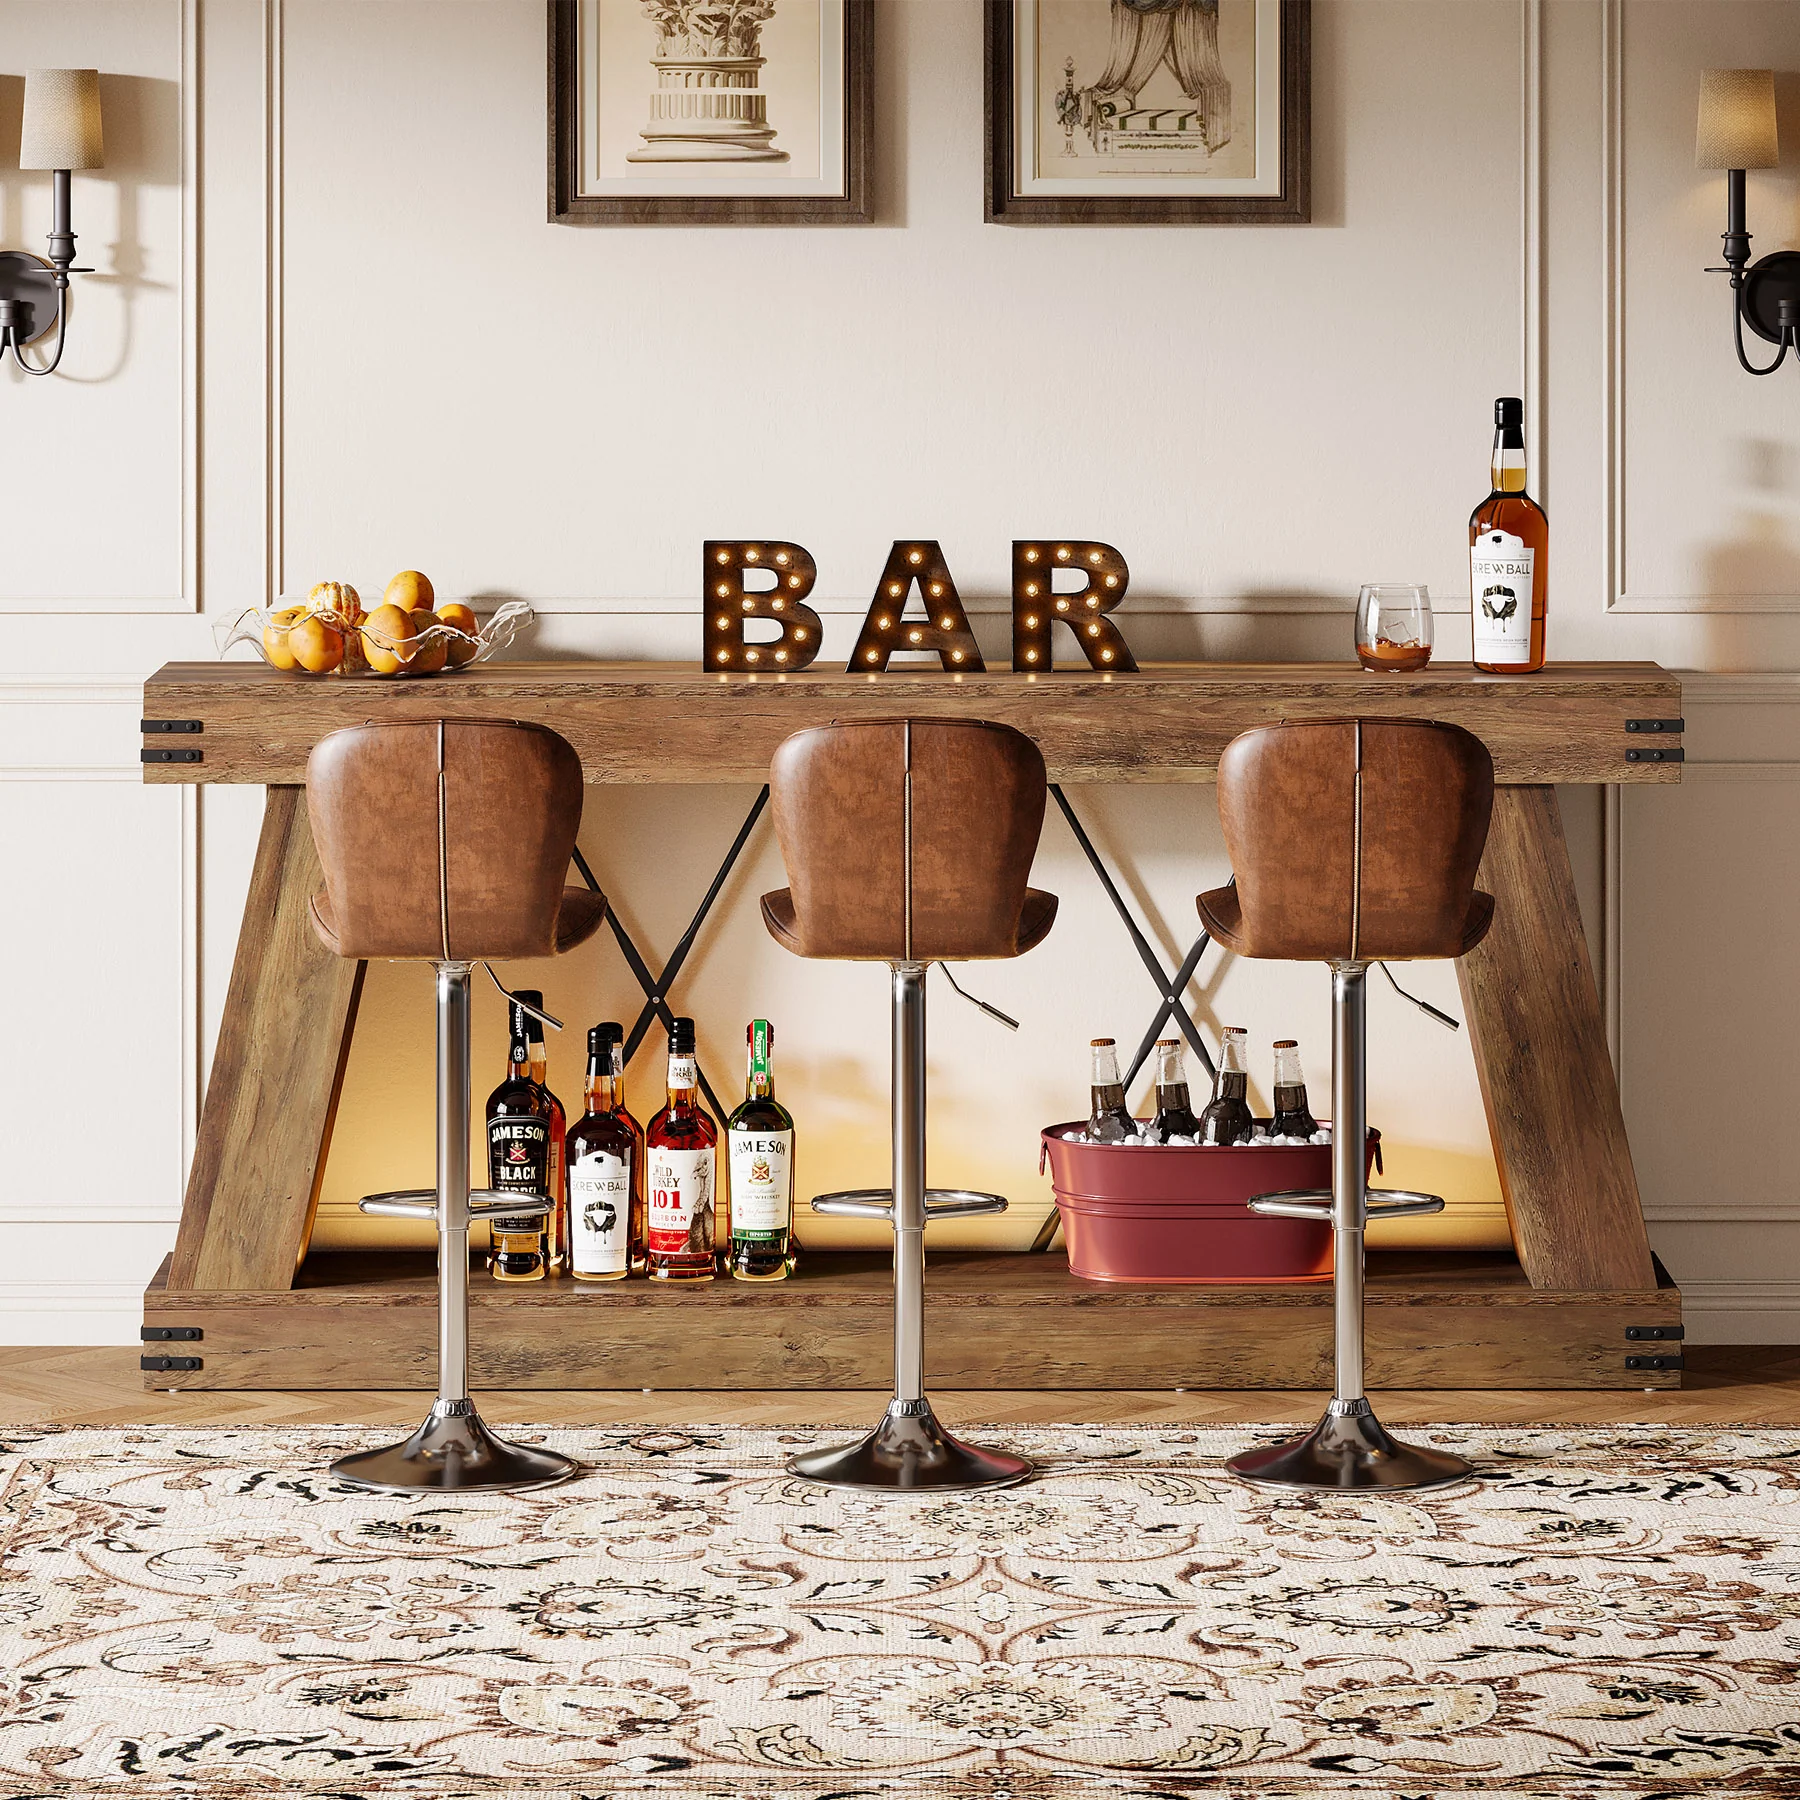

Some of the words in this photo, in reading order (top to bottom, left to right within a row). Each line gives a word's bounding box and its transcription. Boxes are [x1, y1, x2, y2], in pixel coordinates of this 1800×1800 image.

[704, 540, 1140, 674] BAR
[755, 1030, 765, 1065] JAMESON
[491, 1125, 545, 1143] JAMESON
[734, 1140, 788, 1157] JAMESON
[500, 1165, 536, 1180] BLACK
[652, 1190, 684, 1210] 101
